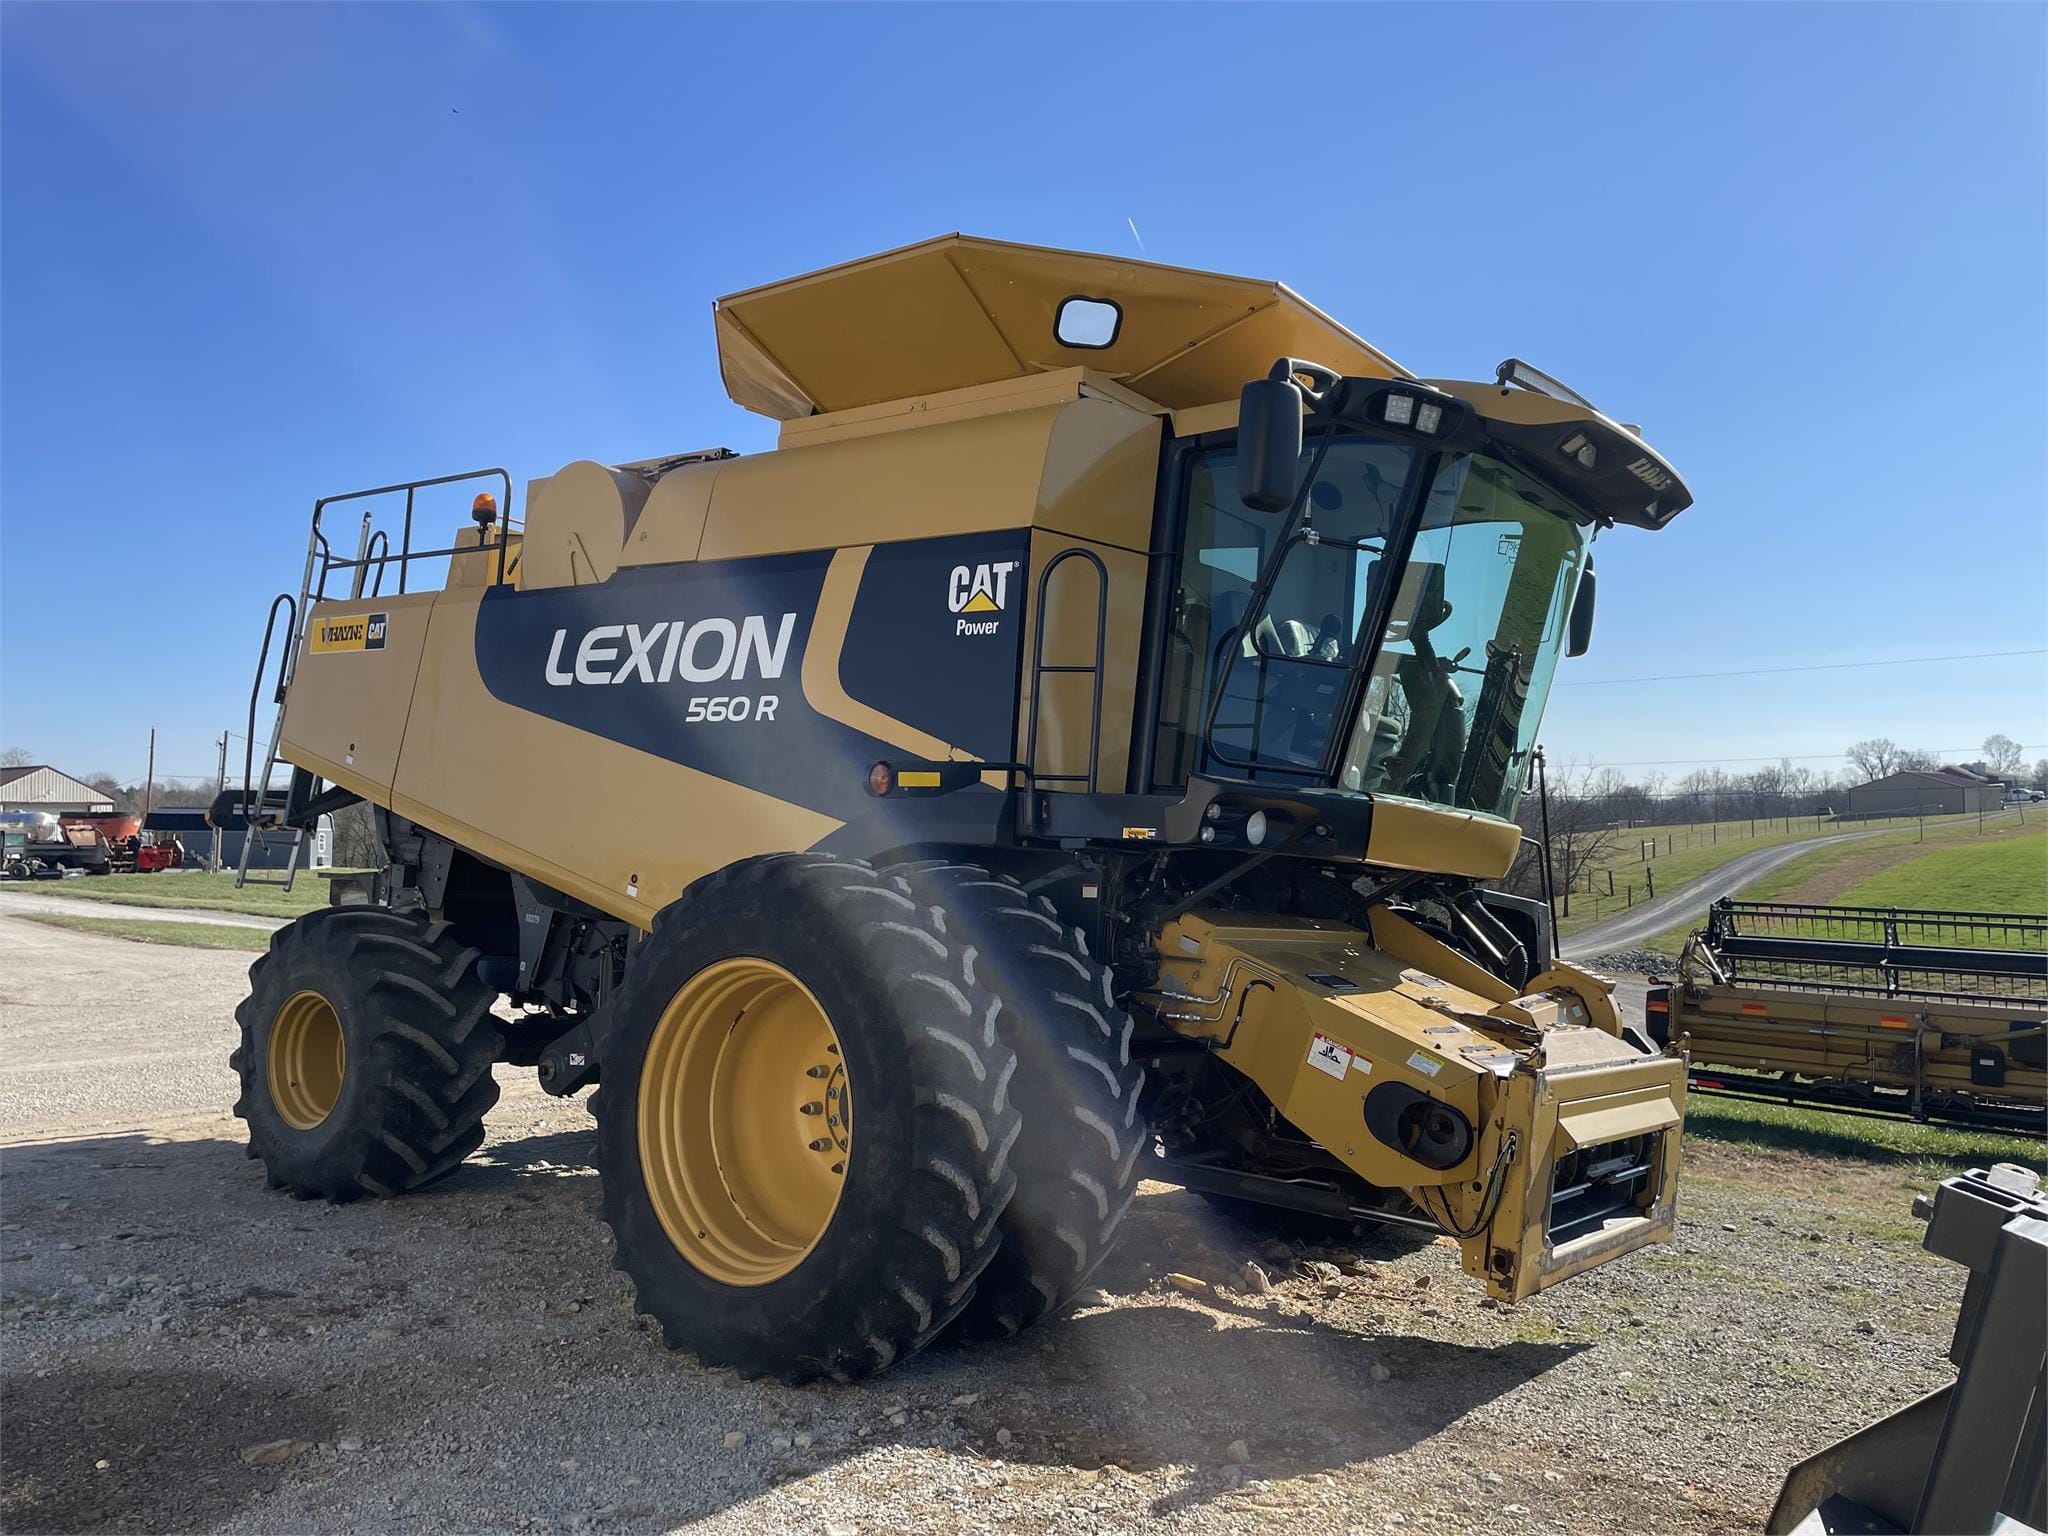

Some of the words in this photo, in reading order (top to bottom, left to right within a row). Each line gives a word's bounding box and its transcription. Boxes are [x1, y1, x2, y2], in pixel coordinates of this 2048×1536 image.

[948, 561, 1014, 613] CAT
[368, 622, 386, 640] CAT
[956, 619, 999, 636] Power
[545, 612, 797, 686] LEXION
[685, 696, 751, 723] 560
[754, 695, 779, 722] R
